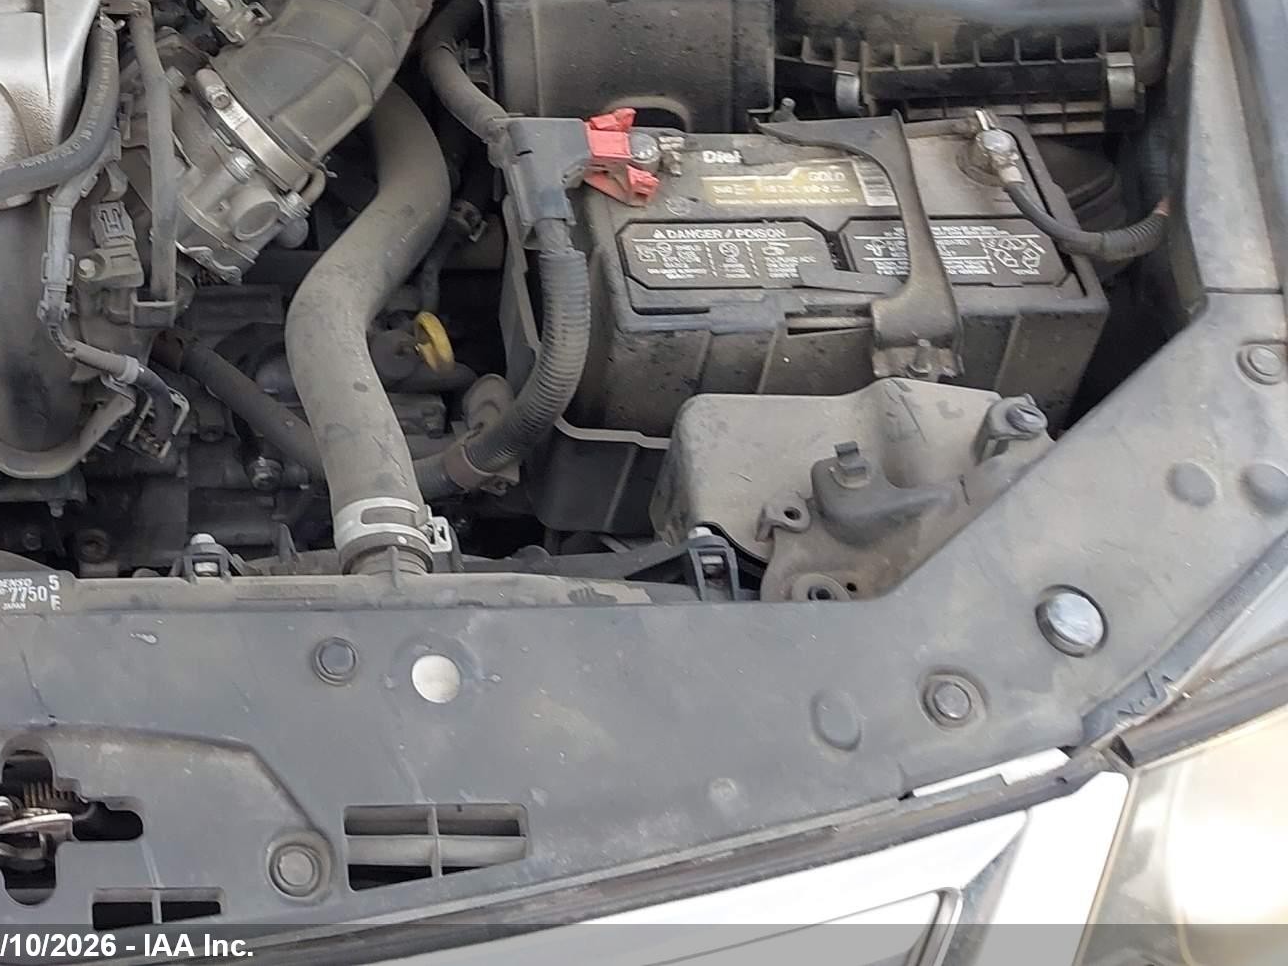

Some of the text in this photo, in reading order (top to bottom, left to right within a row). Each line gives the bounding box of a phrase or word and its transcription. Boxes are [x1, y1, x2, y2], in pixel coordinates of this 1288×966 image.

[808, 171, 845, 182] GOLD
[665, 229, 723, 240] DANGER
[735, 228, 787, 239] POISON
